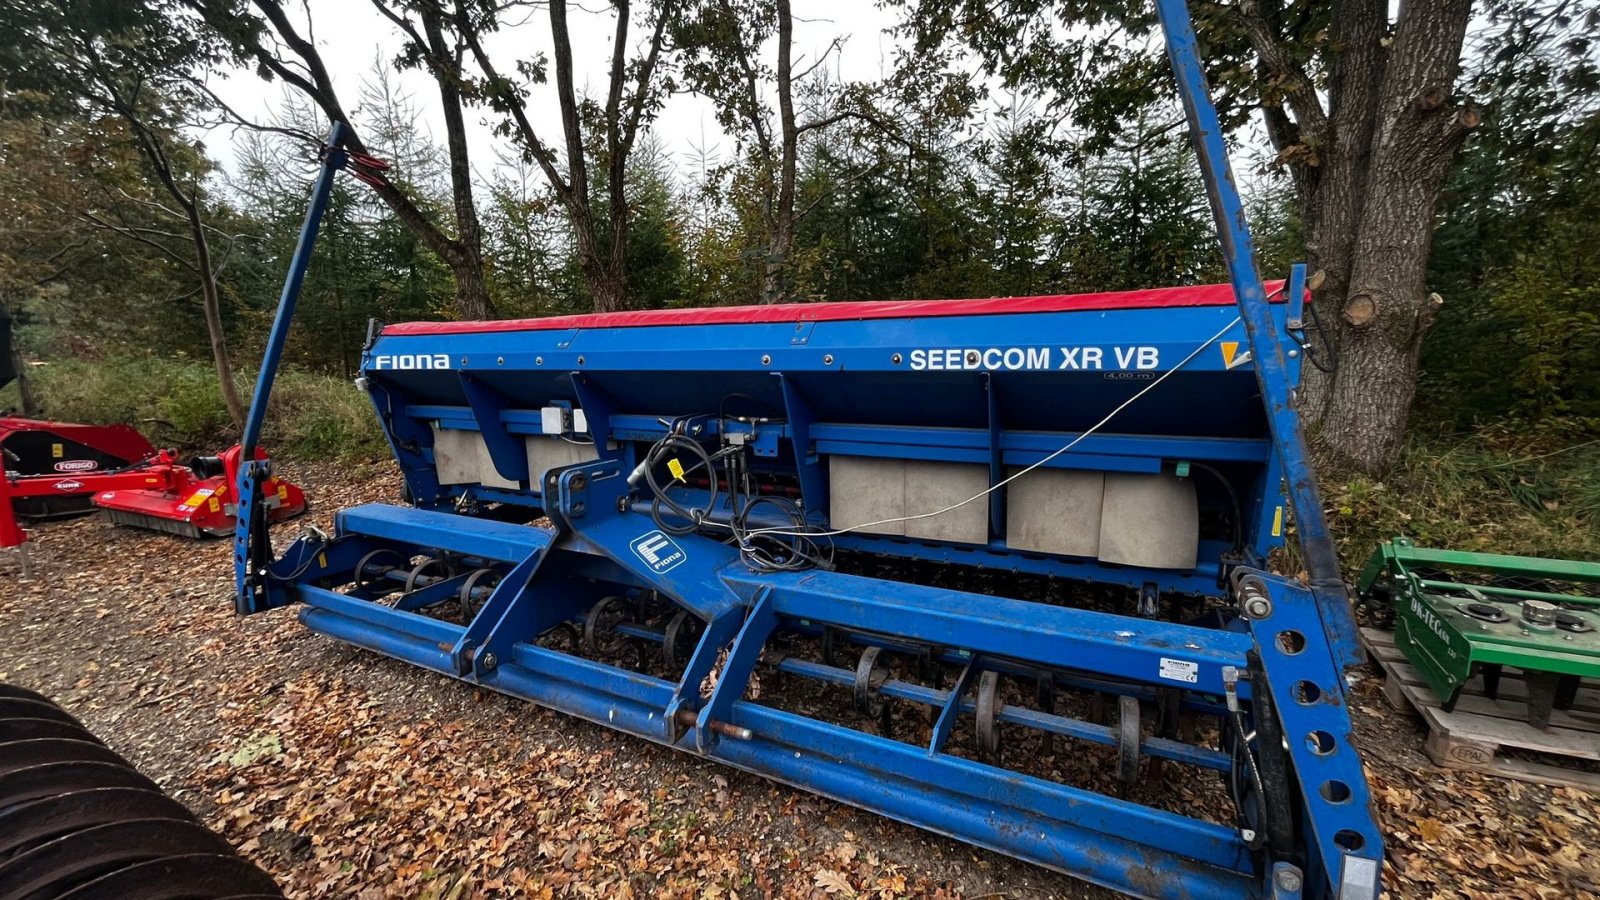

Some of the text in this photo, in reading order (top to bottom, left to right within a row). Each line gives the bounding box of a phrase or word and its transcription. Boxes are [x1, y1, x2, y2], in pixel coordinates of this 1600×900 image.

[910, 346, 1159, 371] SEEDCOM XR VB
[58, 461, 94, 470] FORIGO
[1457, 748, 1483, 762] EPAL
